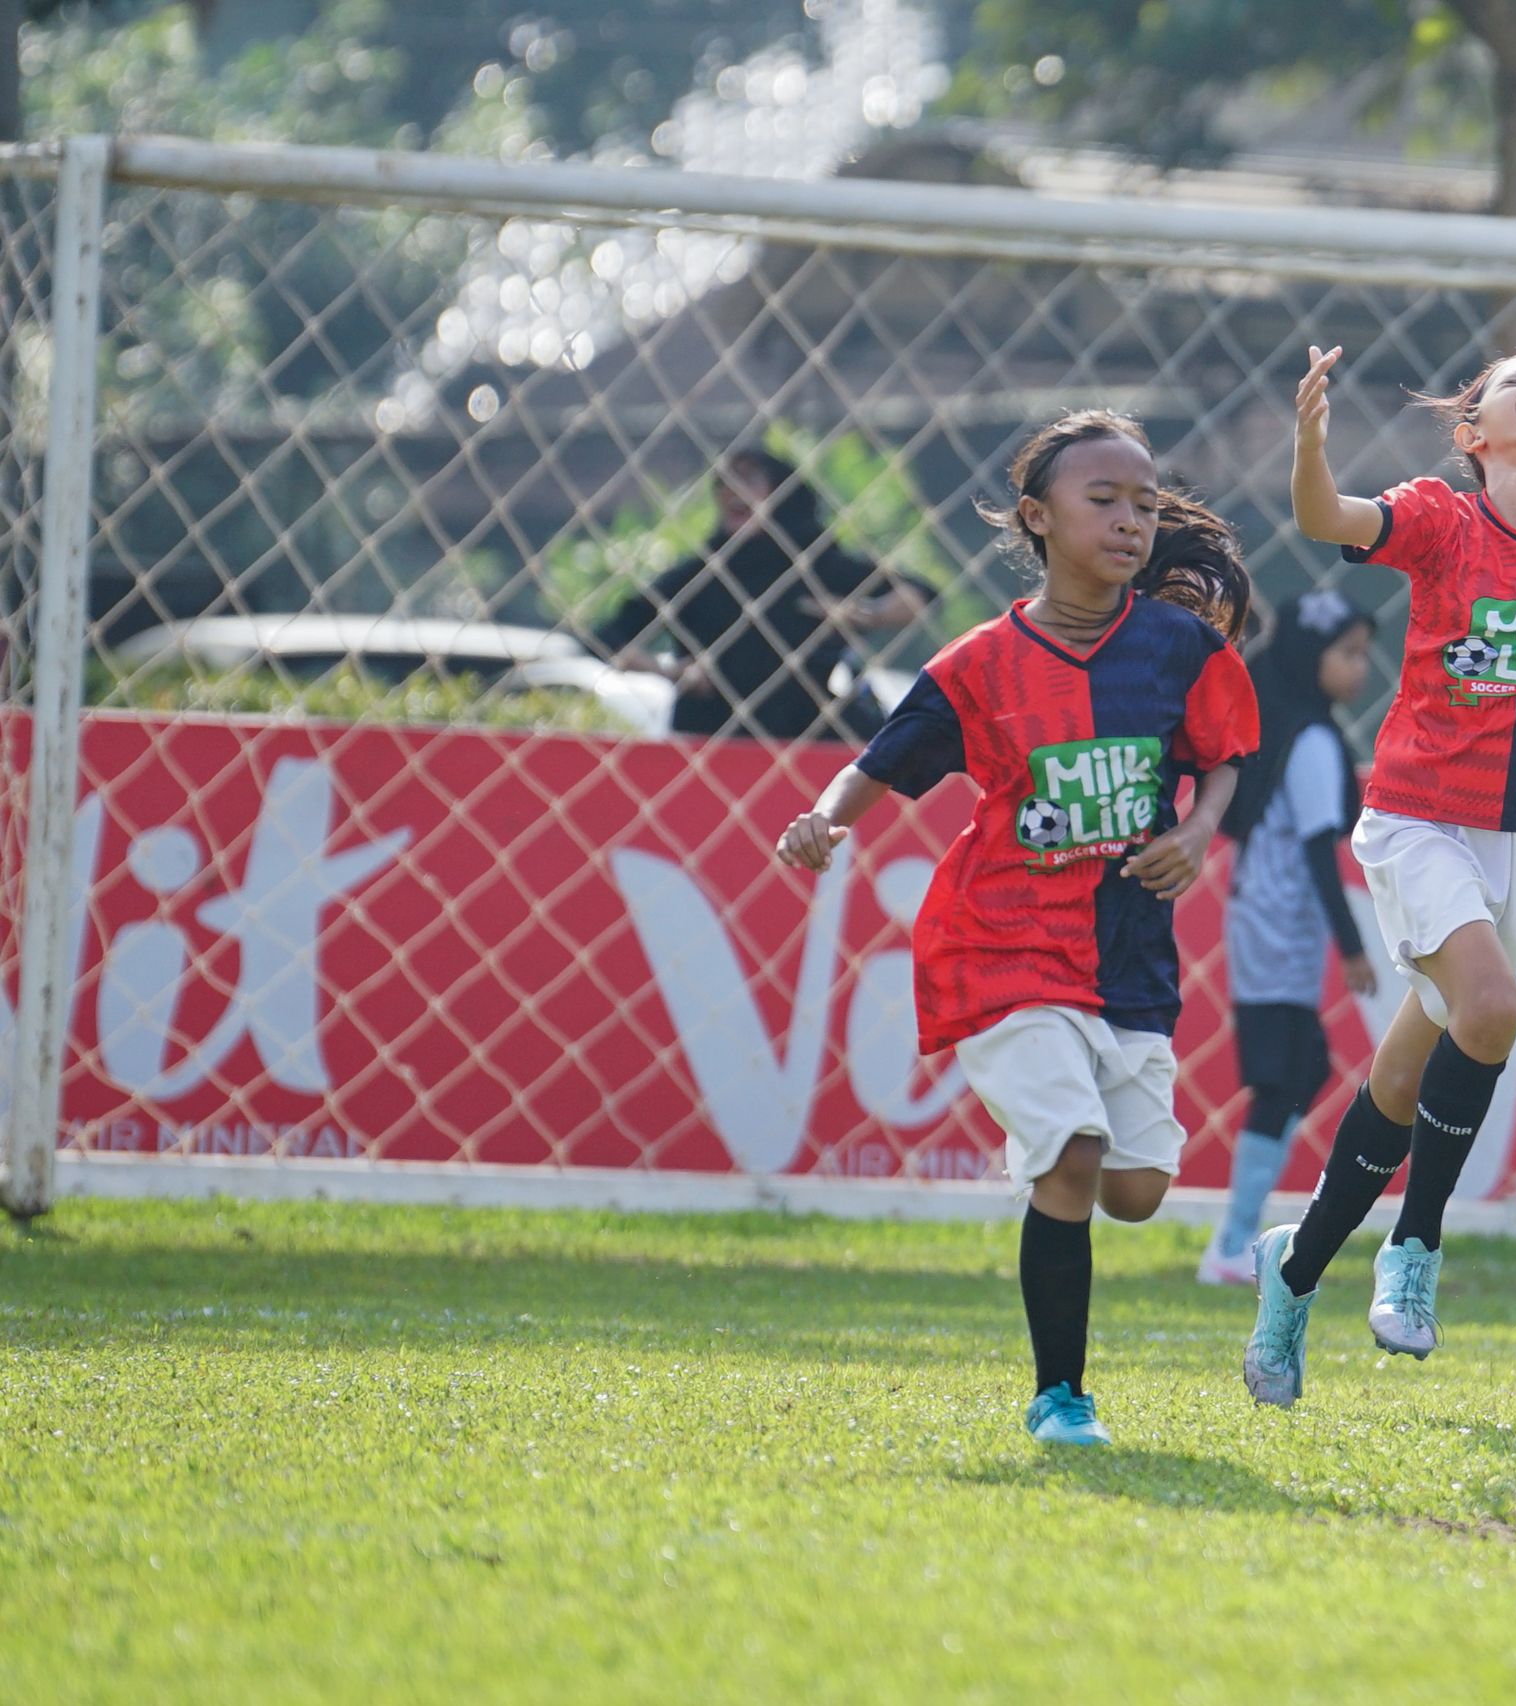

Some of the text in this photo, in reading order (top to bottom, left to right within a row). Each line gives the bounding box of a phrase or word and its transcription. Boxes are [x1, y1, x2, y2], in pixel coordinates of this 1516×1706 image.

[1470, 681, 1515, 693] SOCCER
[1045, 745, 1152, 799] Milk
[1069, 787, 1152, 842] Life
[1053, 845, 1097, 865] SOCCER
